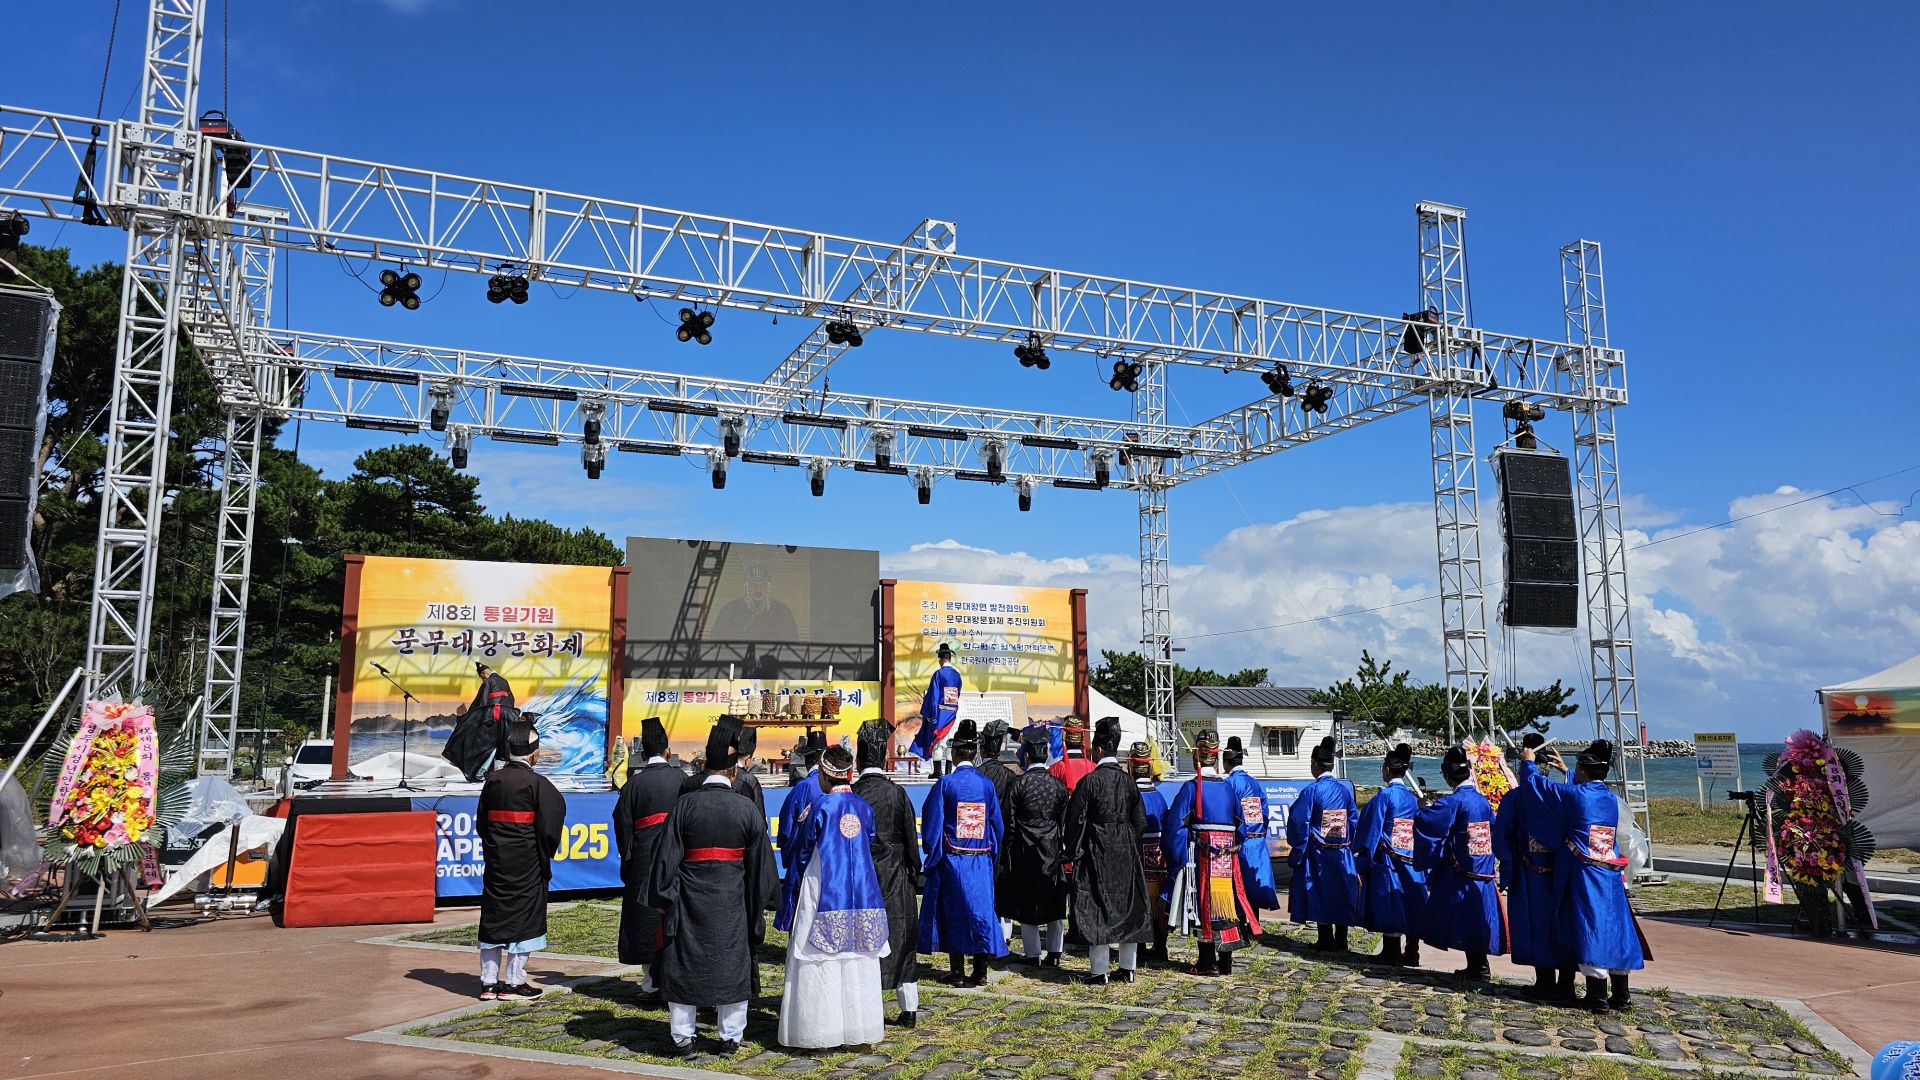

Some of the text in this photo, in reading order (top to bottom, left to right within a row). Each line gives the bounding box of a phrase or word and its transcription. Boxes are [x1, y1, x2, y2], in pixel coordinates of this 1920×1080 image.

[427, 603, 555, 624] 제8회 통일기원
[946, 601, 987, 612] 문무대왕면
[946, 614, 1004, 625] 문무대왕문화제
[1007, 617, 1046, 627] 추진위원회
[391, 628, 584, 658] 문무대왕문화제
[645, 690, 679, 704] 제8회
[682, 691, 732, 704] 통일기원
[436, 812, 479, 836] 20
[436, 838, 485, 862] APE
[552, 822, 609, 862] 025
[436, 863, 486, 878] GYEON
